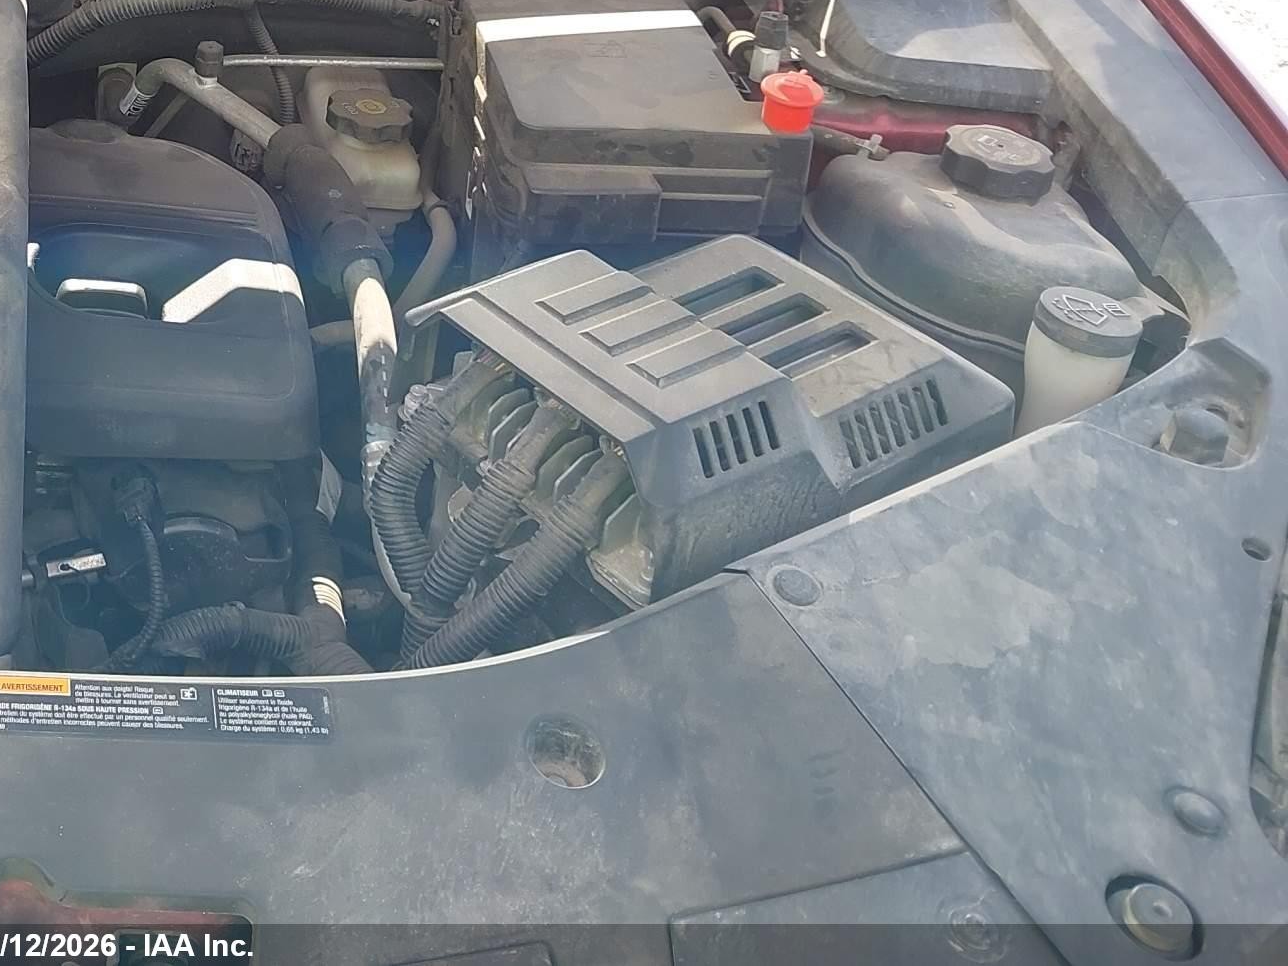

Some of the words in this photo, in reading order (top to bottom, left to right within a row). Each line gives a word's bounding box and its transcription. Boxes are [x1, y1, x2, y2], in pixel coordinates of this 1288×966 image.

[1, 682, 64, 692] AVERTISSEMENT
[54, 704, 76, 712] R-134a
[118, 706, 149, 714] PRESSION
[64, 718, 96, 726] incorrectes
[228, 718, 253, 726] système
